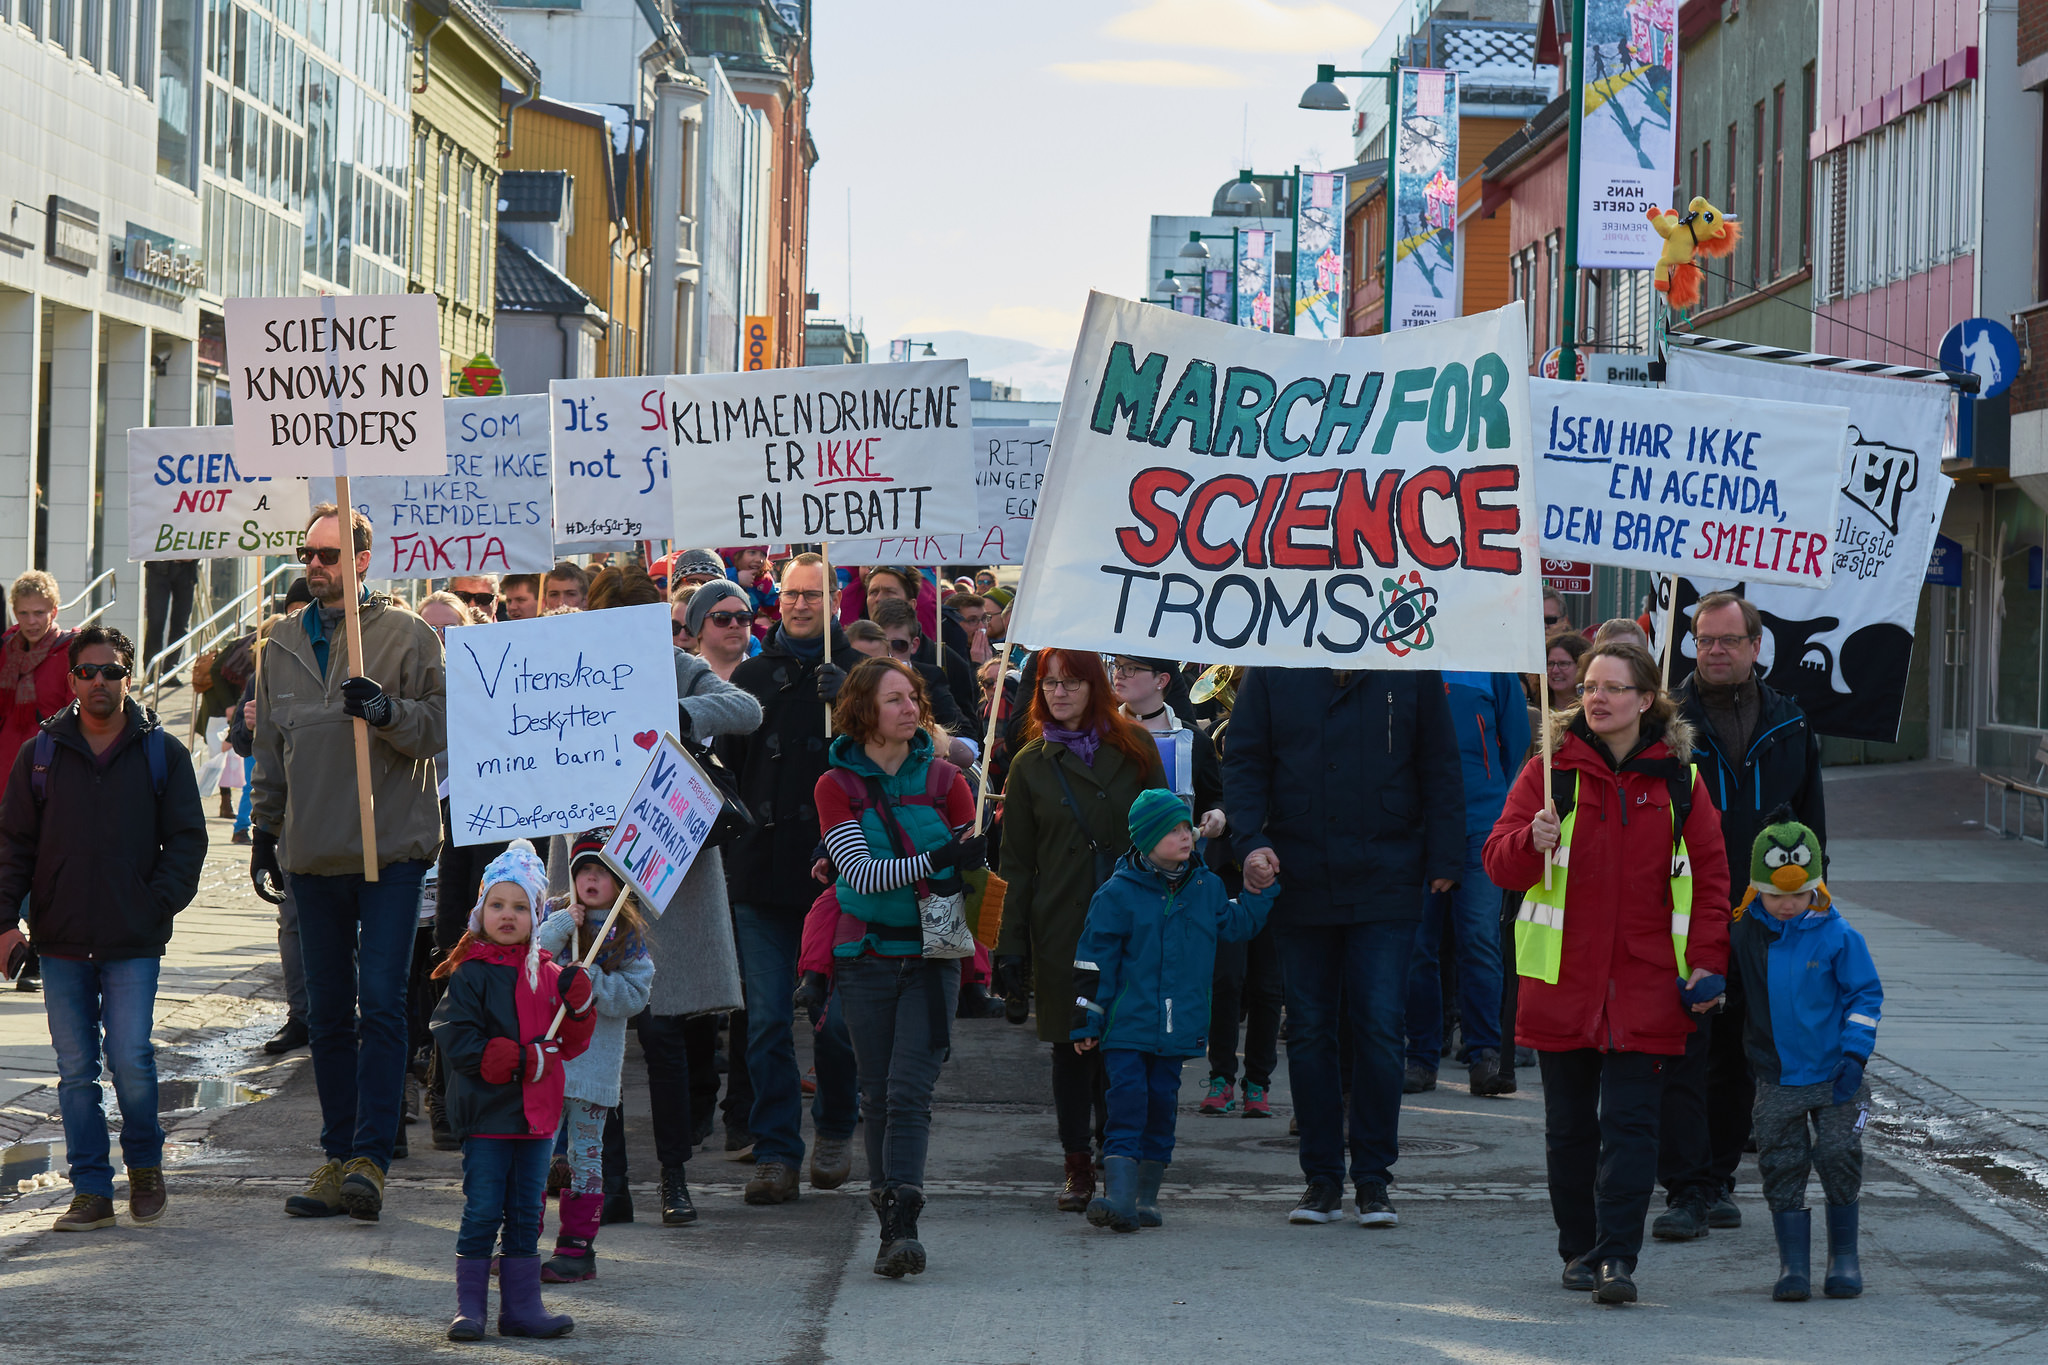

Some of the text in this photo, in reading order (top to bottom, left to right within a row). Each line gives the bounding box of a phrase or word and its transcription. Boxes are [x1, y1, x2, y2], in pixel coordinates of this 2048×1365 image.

[264, 315, 397, 353] SCIENCE
[244, 362, 429, 401] KNOWS NO
[1607, 367, 1648, 380] Brille
[561, 395, 609, 432] It's
[671, 385, 960, 446] KLIMAENDRINGENE
[1090, 341, 1511, 462] MARCH FOR
[270, 410, 418, 452] BORDERS
[460, 412, 521, 442] SOM
[1549, 405, 1762, 471] ISEN HAR IKKE
[153, 453, 273, 486] SCIEN
[495, 452, 549, 478] IKKE
[569, 449, 621, 478] not
[765, 437, 882, 483] ER IKKE
[172, 489, 271, 514] NOT A
[404, 479, 488, 502] LIKER
[1608, 463, 1787, 523] EN AGENDA,
[391, 500, 541, 527] FREMDELES
[738, 486, 933, 539] EN DEBATT
[1114, 464, 1523, 576] SCIENCE
[154, 523, 231, 553] BELIEF
[389, 531, 511, 573] FAKTA
[1543, 504, 1828, 579] DEN BARE SMELTER
[1555, 580, 1563, 588] 11
[1571, 581, 1579, 589] 13
[508, 702, 617, 742] beskytter
[476, 755, 537, 778] mine
[650, 750, 710, 845] Vi HAR INGEN
[465, 802, 617, 836] #Derforgårjeg
[633, 798, 692, 868] ALTERNATIV
[613, 823, 675, 899] PLANET
